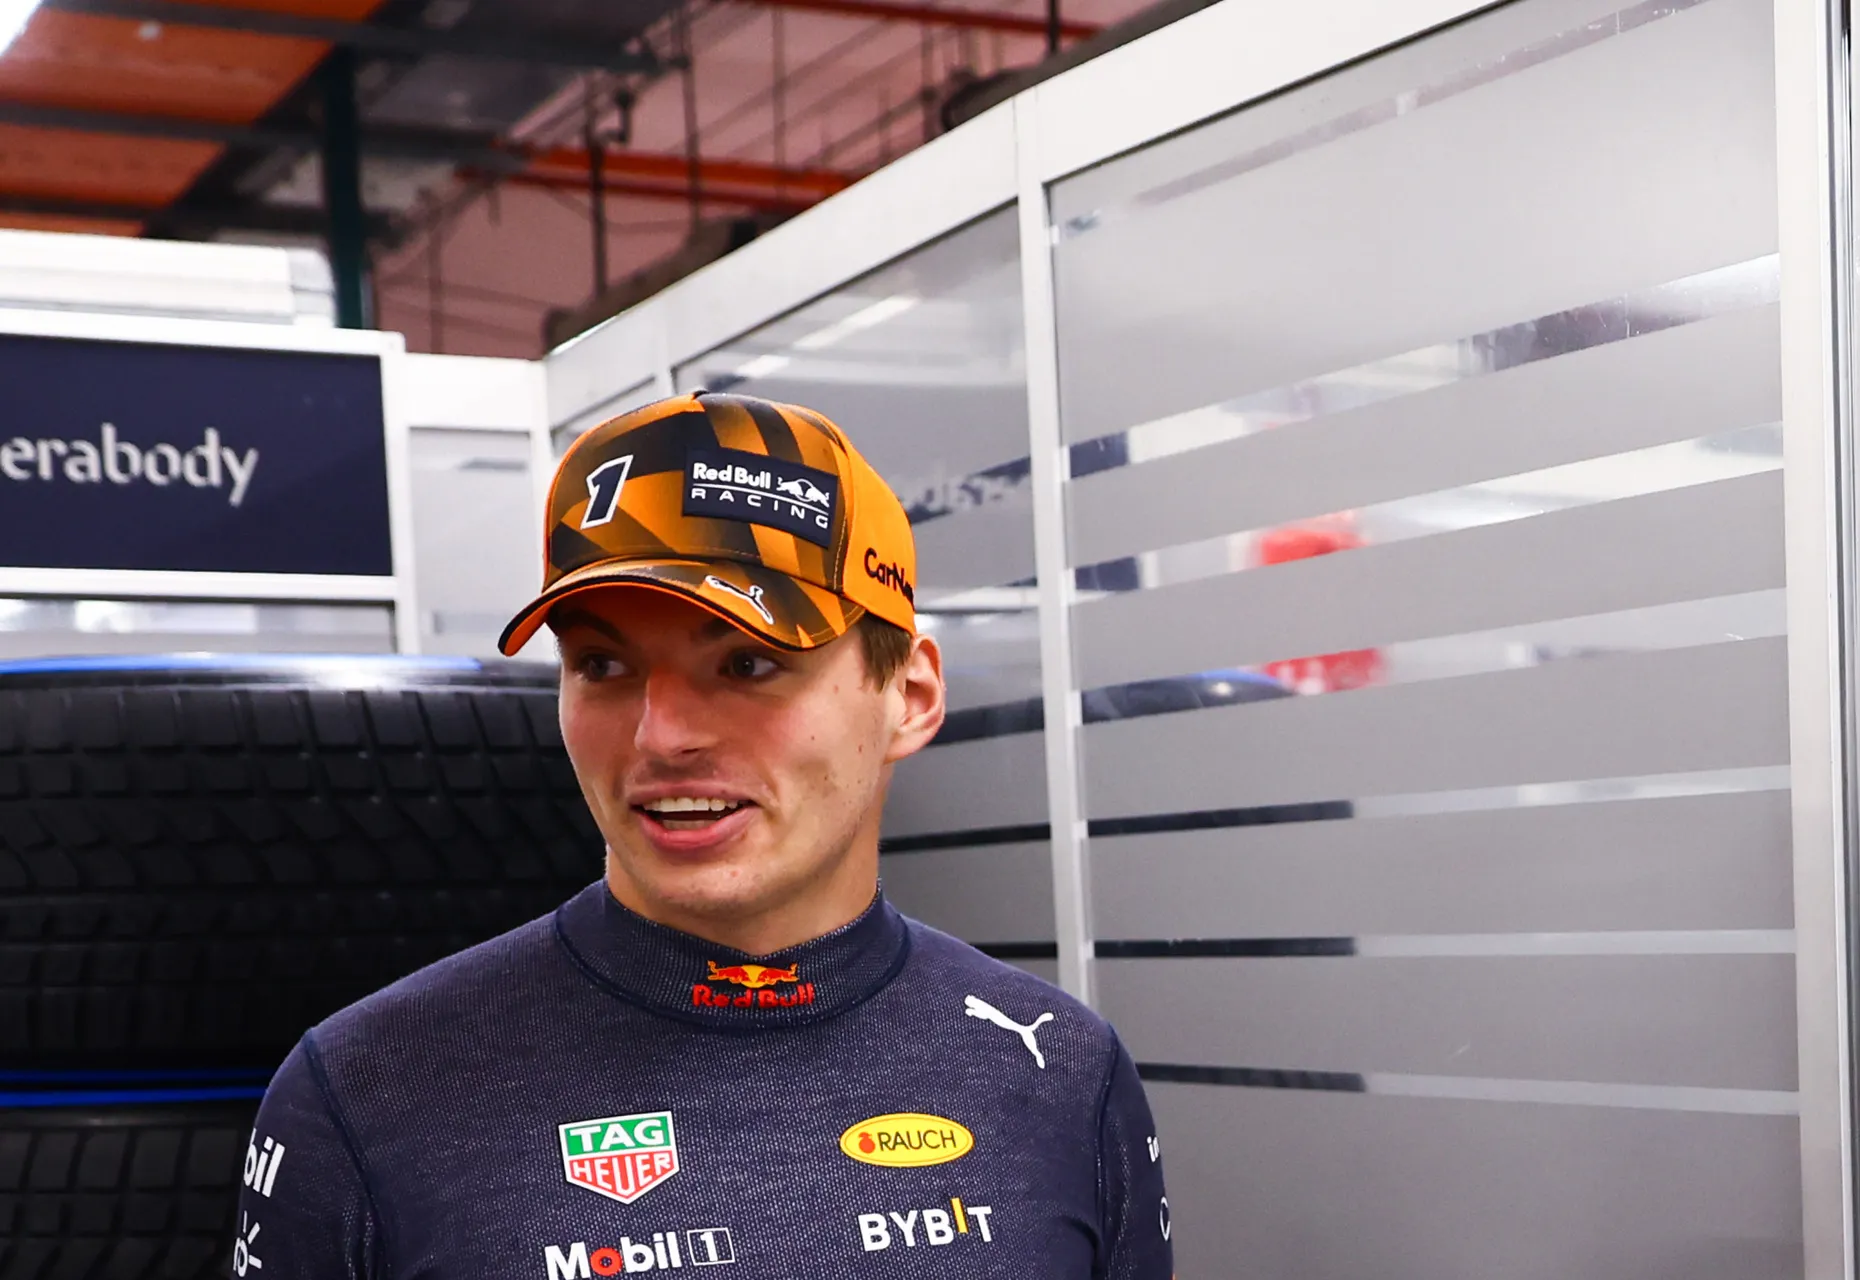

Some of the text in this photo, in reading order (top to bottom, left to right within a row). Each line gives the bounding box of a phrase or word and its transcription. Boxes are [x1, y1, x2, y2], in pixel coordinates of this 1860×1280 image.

[0, 422, 260, 507] erabody
[693, 463, 771, 489] Red Bull
[580, 454, 634, 531] 1
[691, 487, 830, 529] RACING
[692, 983, 815, 1009] Red Bull
[570, 1120, 665, 1149] TAG
[877, 1127, 957, 1151] RAUCH
[571, 1152, 672, 1199] HEUER
[858, 1197, 993, 1251] BYBIT
